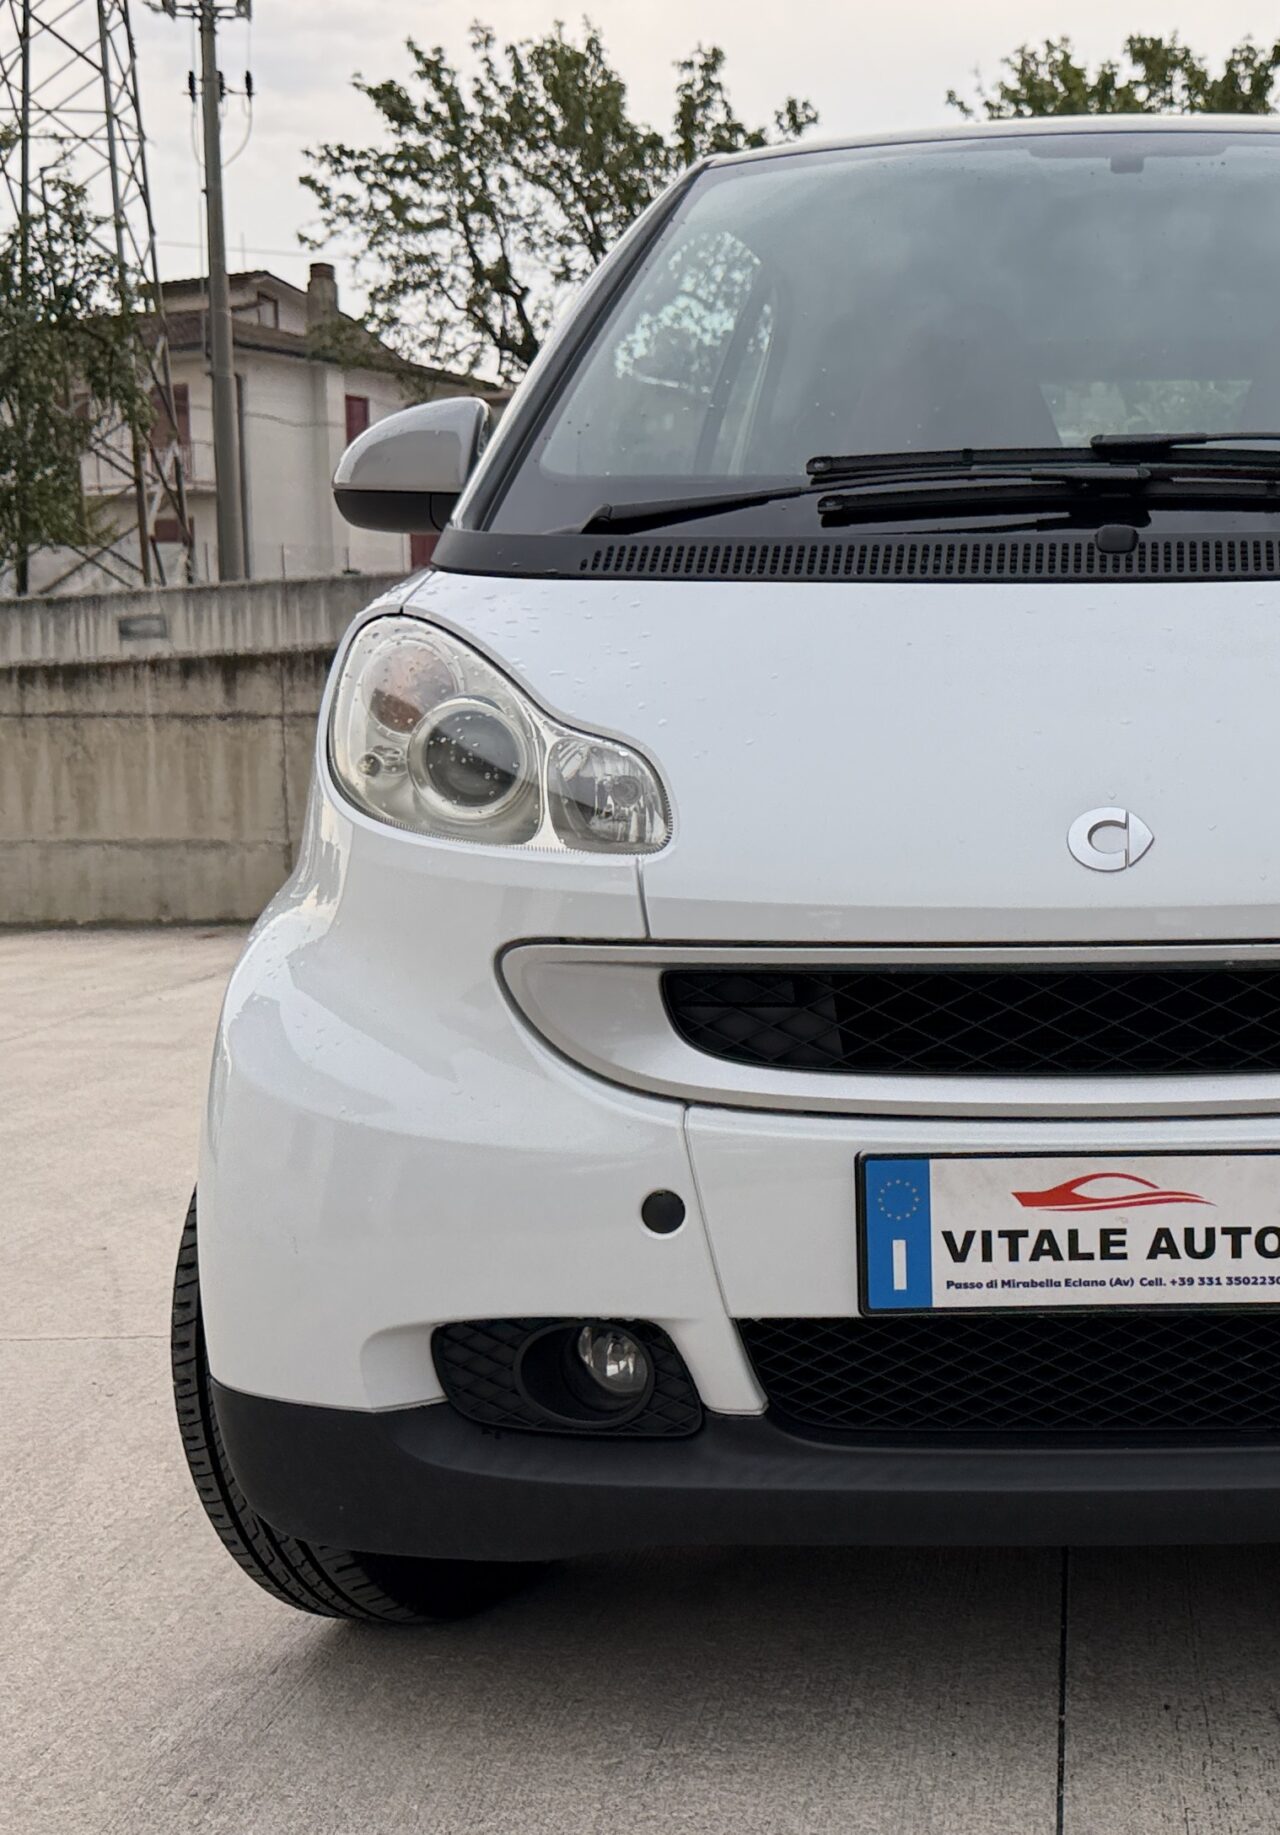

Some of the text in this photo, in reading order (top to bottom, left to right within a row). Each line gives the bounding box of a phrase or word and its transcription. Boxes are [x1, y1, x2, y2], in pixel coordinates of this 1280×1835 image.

[941, 1228, 1128, 1263] VITALE
[892, 1239, 907, 1291] I
[946, 1279, 983, 1290] Passo
[986, 1279, 998, 1289] di
[1001, 1278, 1061, 1289] Mirabella
[1064, 1277, 1106, 1288] Eclano
[1109, 1277, 1135, 1289] (Av)
[1139, 1277, 1167, 1287] Cell.
[1170, 1276, 1195, 1287] +39
[1198, 1276, 1223, 1286] 331
